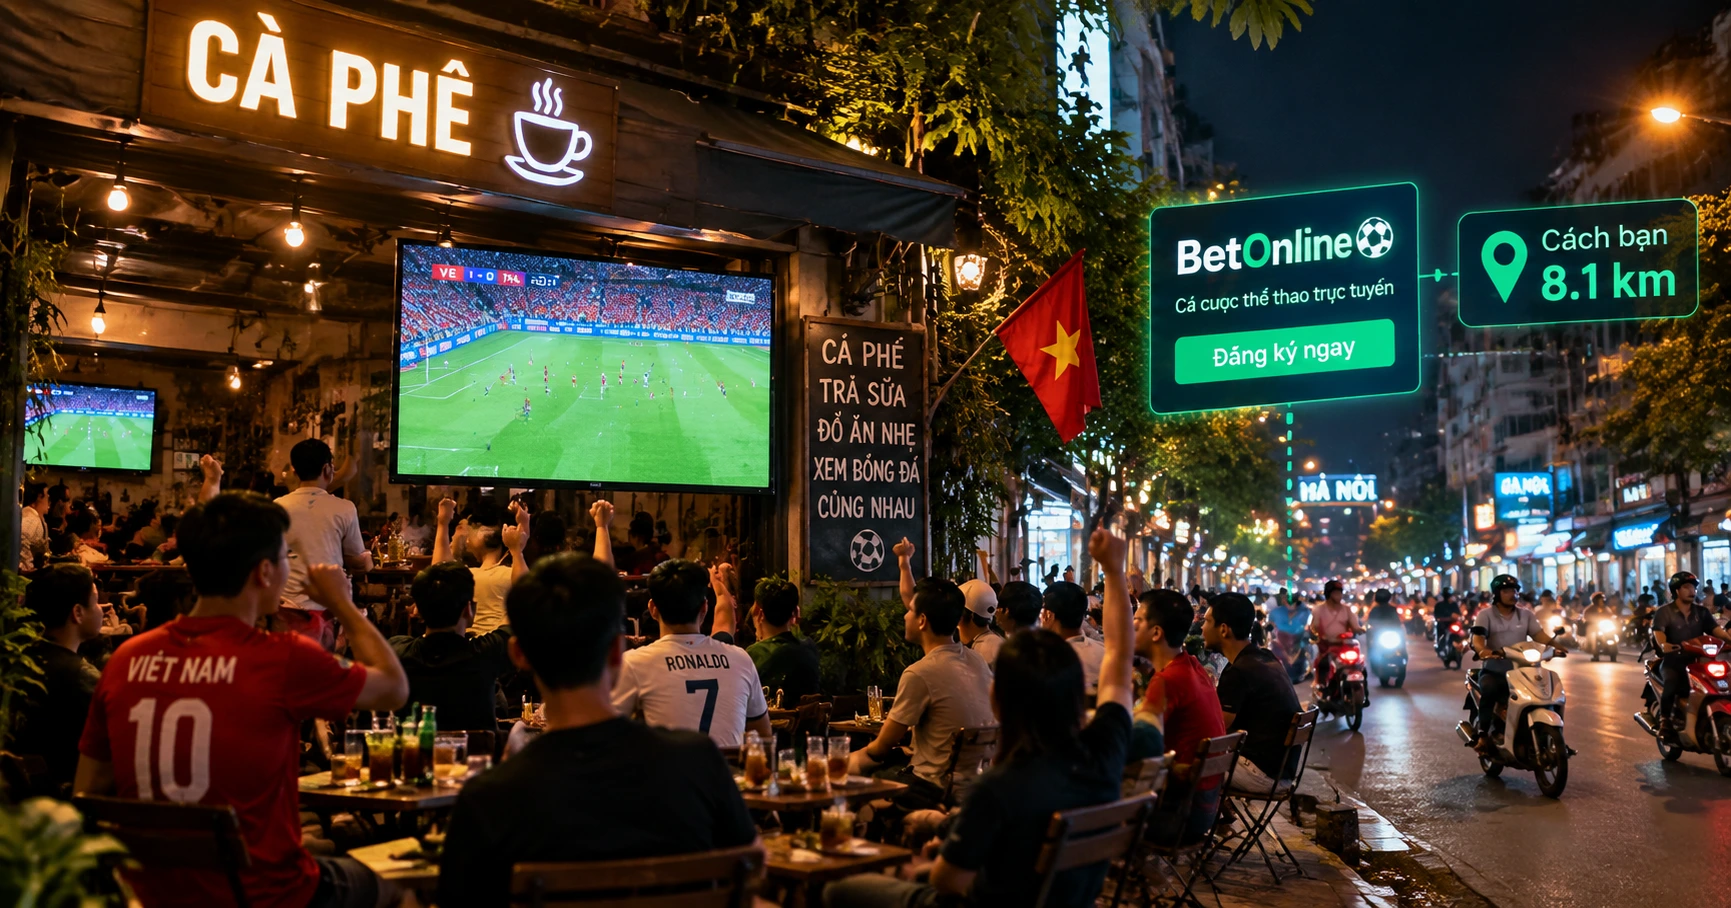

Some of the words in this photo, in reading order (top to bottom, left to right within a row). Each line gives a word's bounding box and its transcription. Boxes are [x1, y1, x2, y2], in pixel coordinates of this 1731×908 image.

[187, 12, 297, 119] CÀ
[329, 49, 474, 156] PHÊ
[881, 422, 916, 453] NHẸ
[813, 457, 847, 482] XEM
[898, 456, 921, 484] ĐÁ
[870, 496, 915, 520] NHAU
[179, 656, 237, 684] NAM
[685, 678, 719, 734] 7
[128, 697, 213, 803] 10
